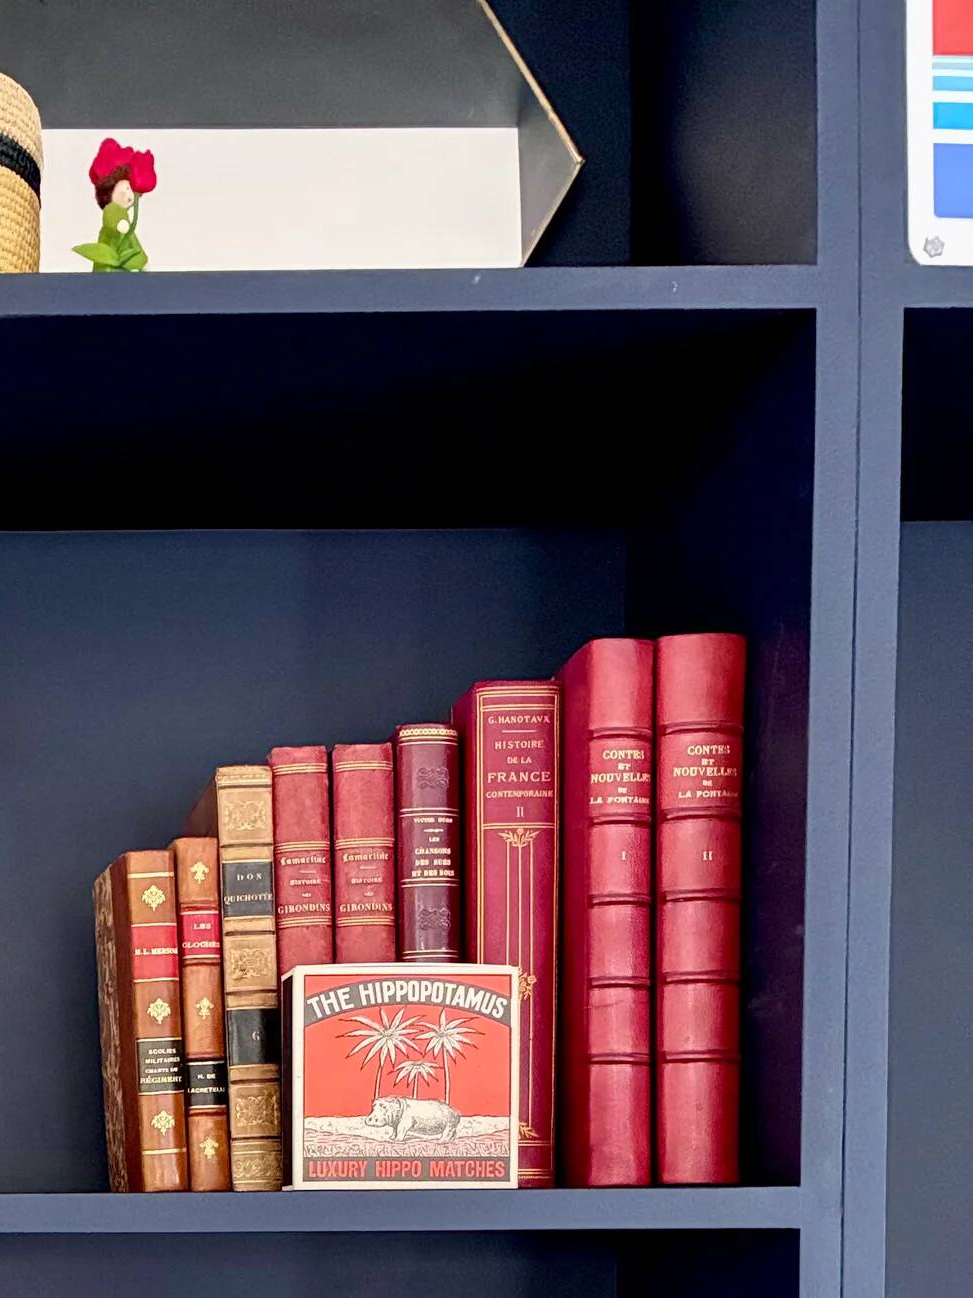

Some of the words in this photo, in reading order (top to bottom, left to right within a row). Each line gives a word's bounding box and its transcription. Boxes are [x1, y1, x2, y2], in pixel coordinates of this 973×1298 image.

[494, 739, 545, 750] HISTOIRE
[602, 749, 645, 760] CONTES
[687, 744, 731, 757] CONTES
[506, 756, 518, 764] DE
[520, 756, 532, 764] LA
[701, 757, 716, 766] ET
[617, 762, 632, 771] ET
[487, 771, 552, 784] FRANCE
[485, 789, 554, 799] CONTEMPORAINE
[678, 790, 692, 799] LA
[589, 796, 603, 805] LA
[516, 806, 525, 818] II
[414, 847, 451, 855] CHANSONS
[280, 855, 327, 867] Lamartine
[342, 851, 389, 864] Lamartine
[433, 858, 451, 866] RUES
[423, 869, 438, 877] DES
[439, 869, 455, 877] BOIS
[223, 893, 273, 906] QUICHOTTE
[277, 903, 331, 915] GIRONDINS
[339, 902, 394, 913] GIRONDINS
[193, 923, 212, 931] LES
[306, 992, 355, 1020] THE
[358, 979, 508, 1020] HIPPOPOTAMUS
[140, 1075, 183, 1085] RÉGIMENT
[307, 1160, 367, 1178] LUXURY
[375, 1160, 422, 1178] HIPPO
[429, 1160, 505, 1178] MATCHES
